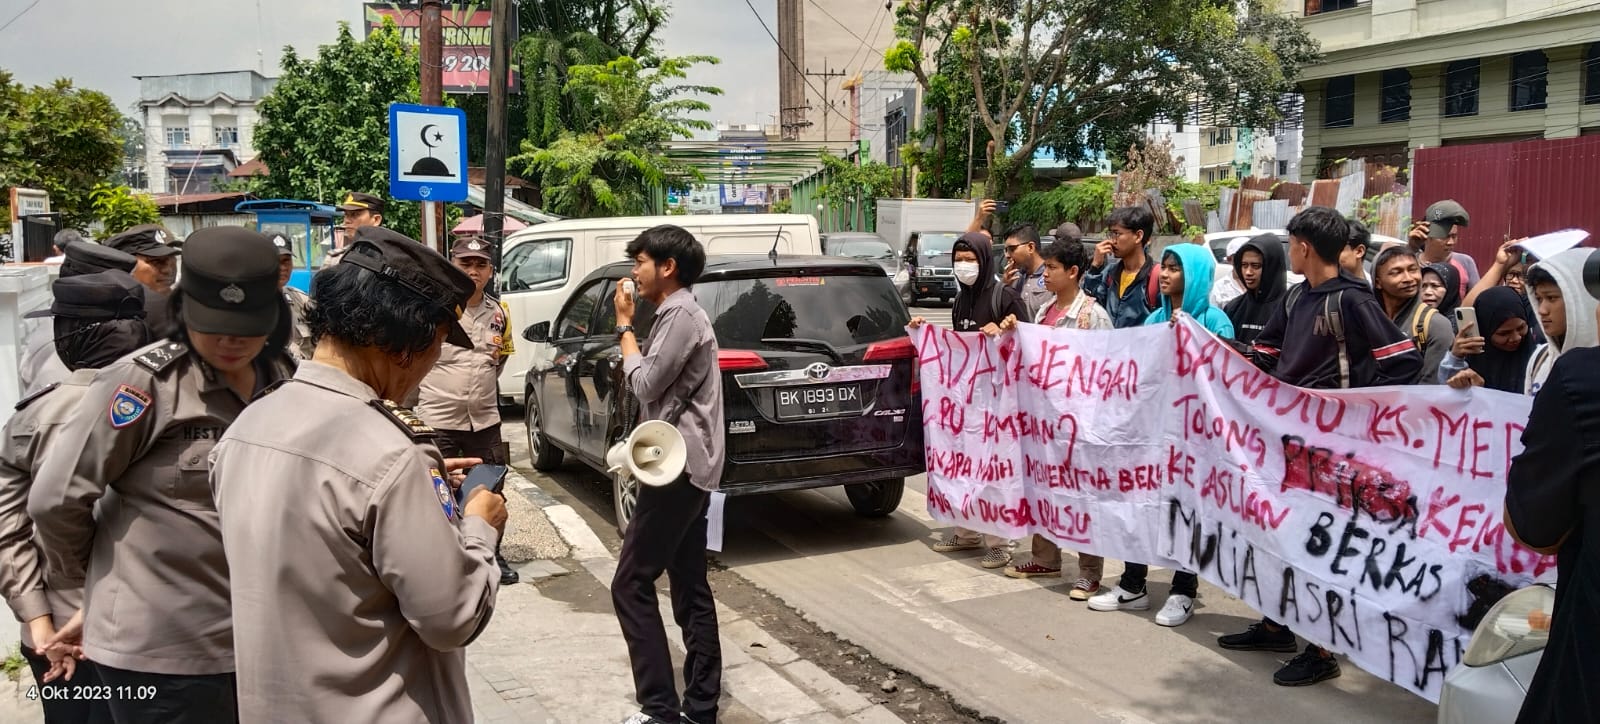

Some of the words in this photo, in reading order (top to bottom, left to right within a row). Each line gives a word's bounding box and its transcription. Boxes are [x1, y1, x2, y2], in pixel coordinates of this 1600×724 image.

[780, 390, 800, 406] BK
[803, 388, 835, 404] 1893
[838, 386, 857, 401] DX
[1306, 511, 1443, 602] BERKAS
